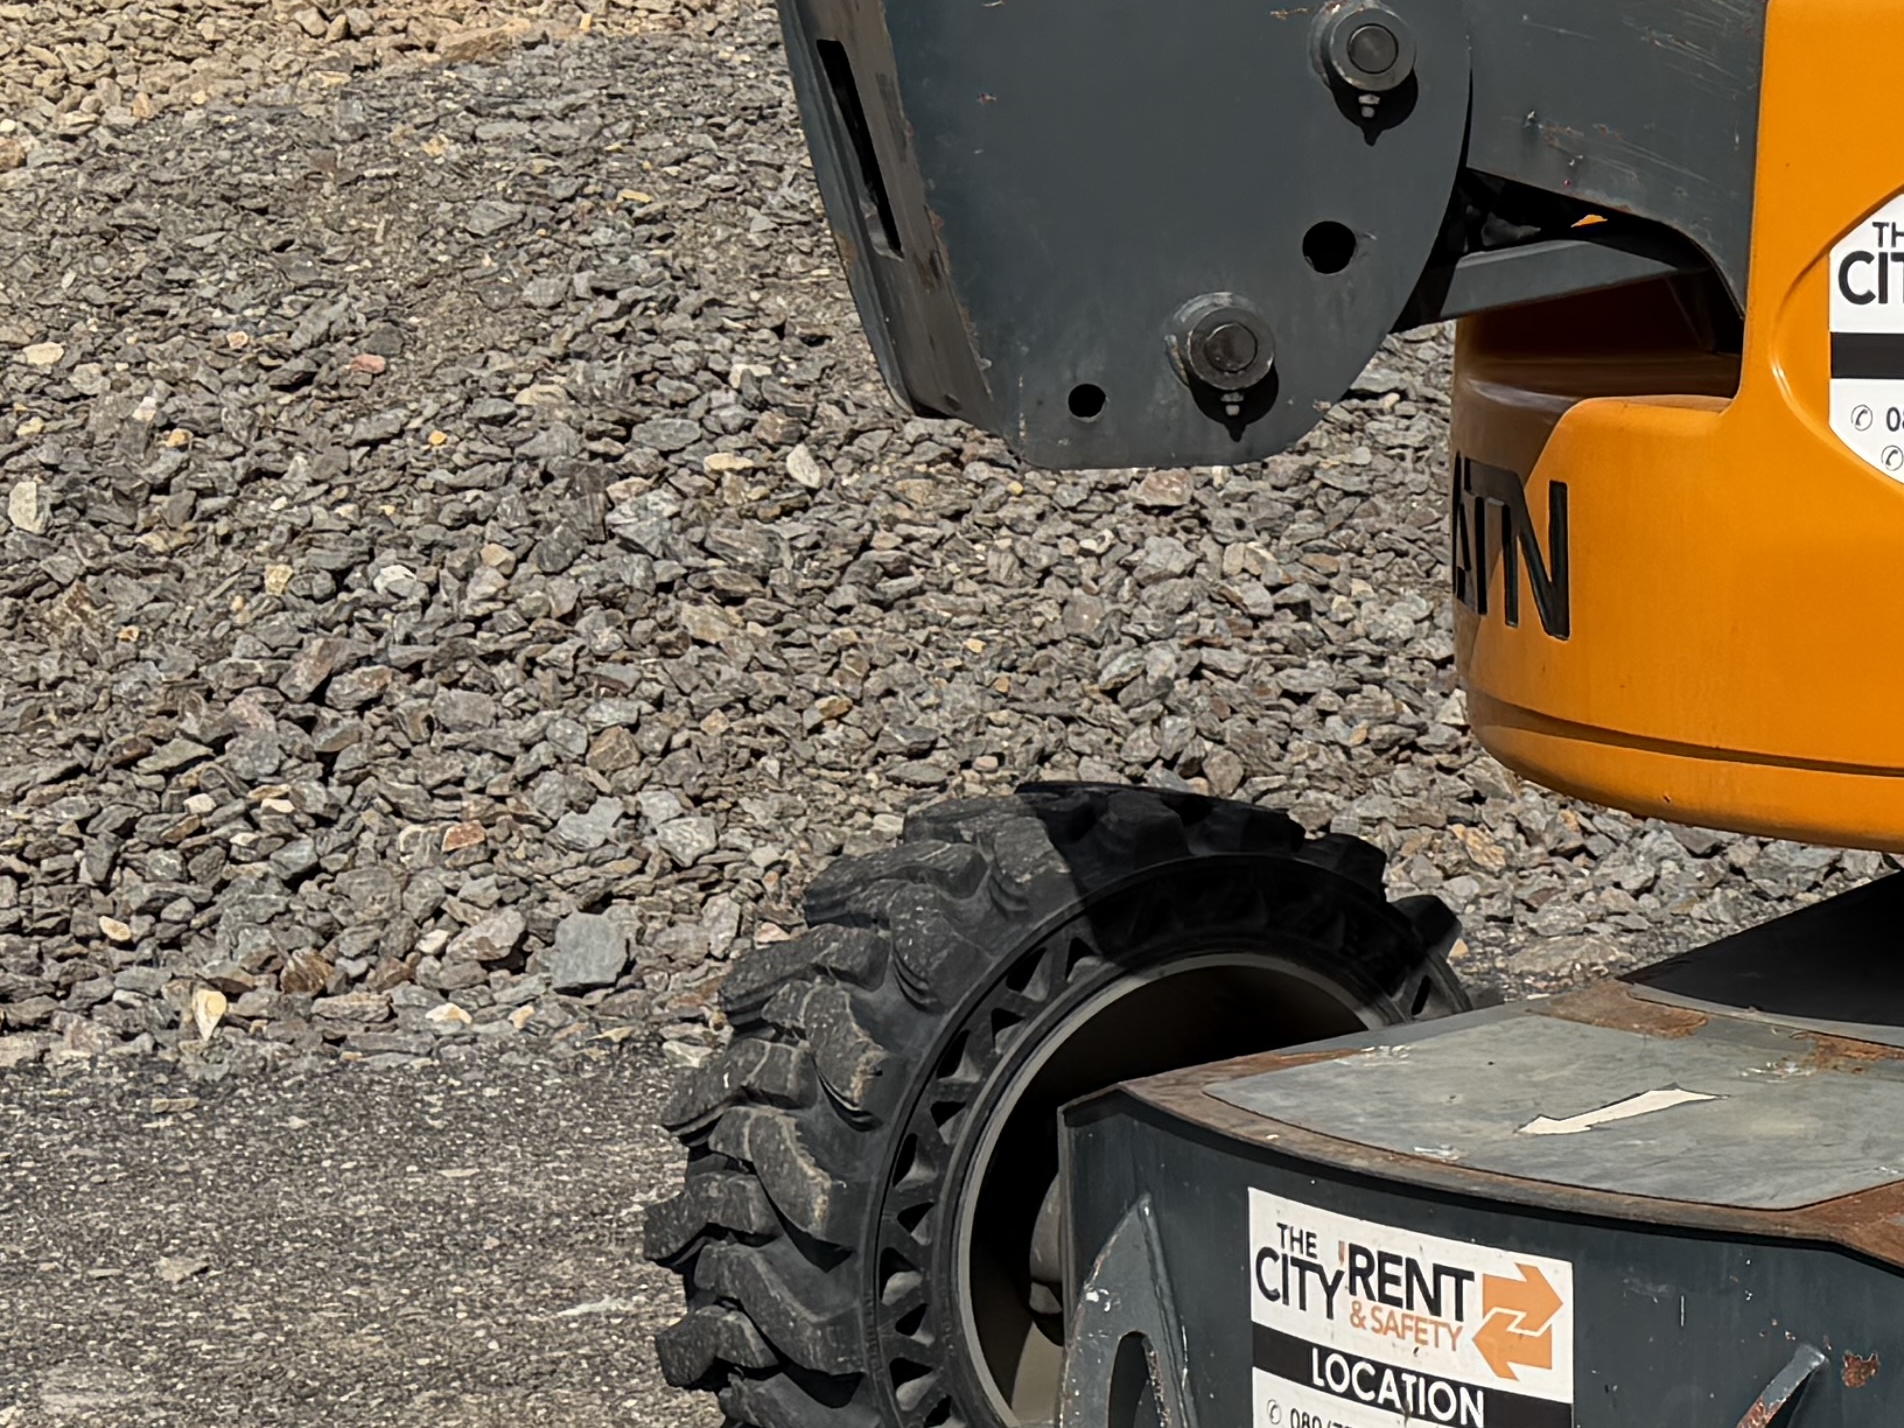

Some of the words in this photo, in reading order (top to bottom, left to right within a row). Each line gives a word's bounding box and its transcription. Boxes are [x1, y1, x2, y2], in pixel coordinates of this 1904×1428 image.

[1276, 1222, 1317, 1259] THE
[1350, 1300, 1367, 1329] &
[1371, 1304, 1463, 1352] SAFETY
[1311, 1348, 1485, 1428] LOCATION
